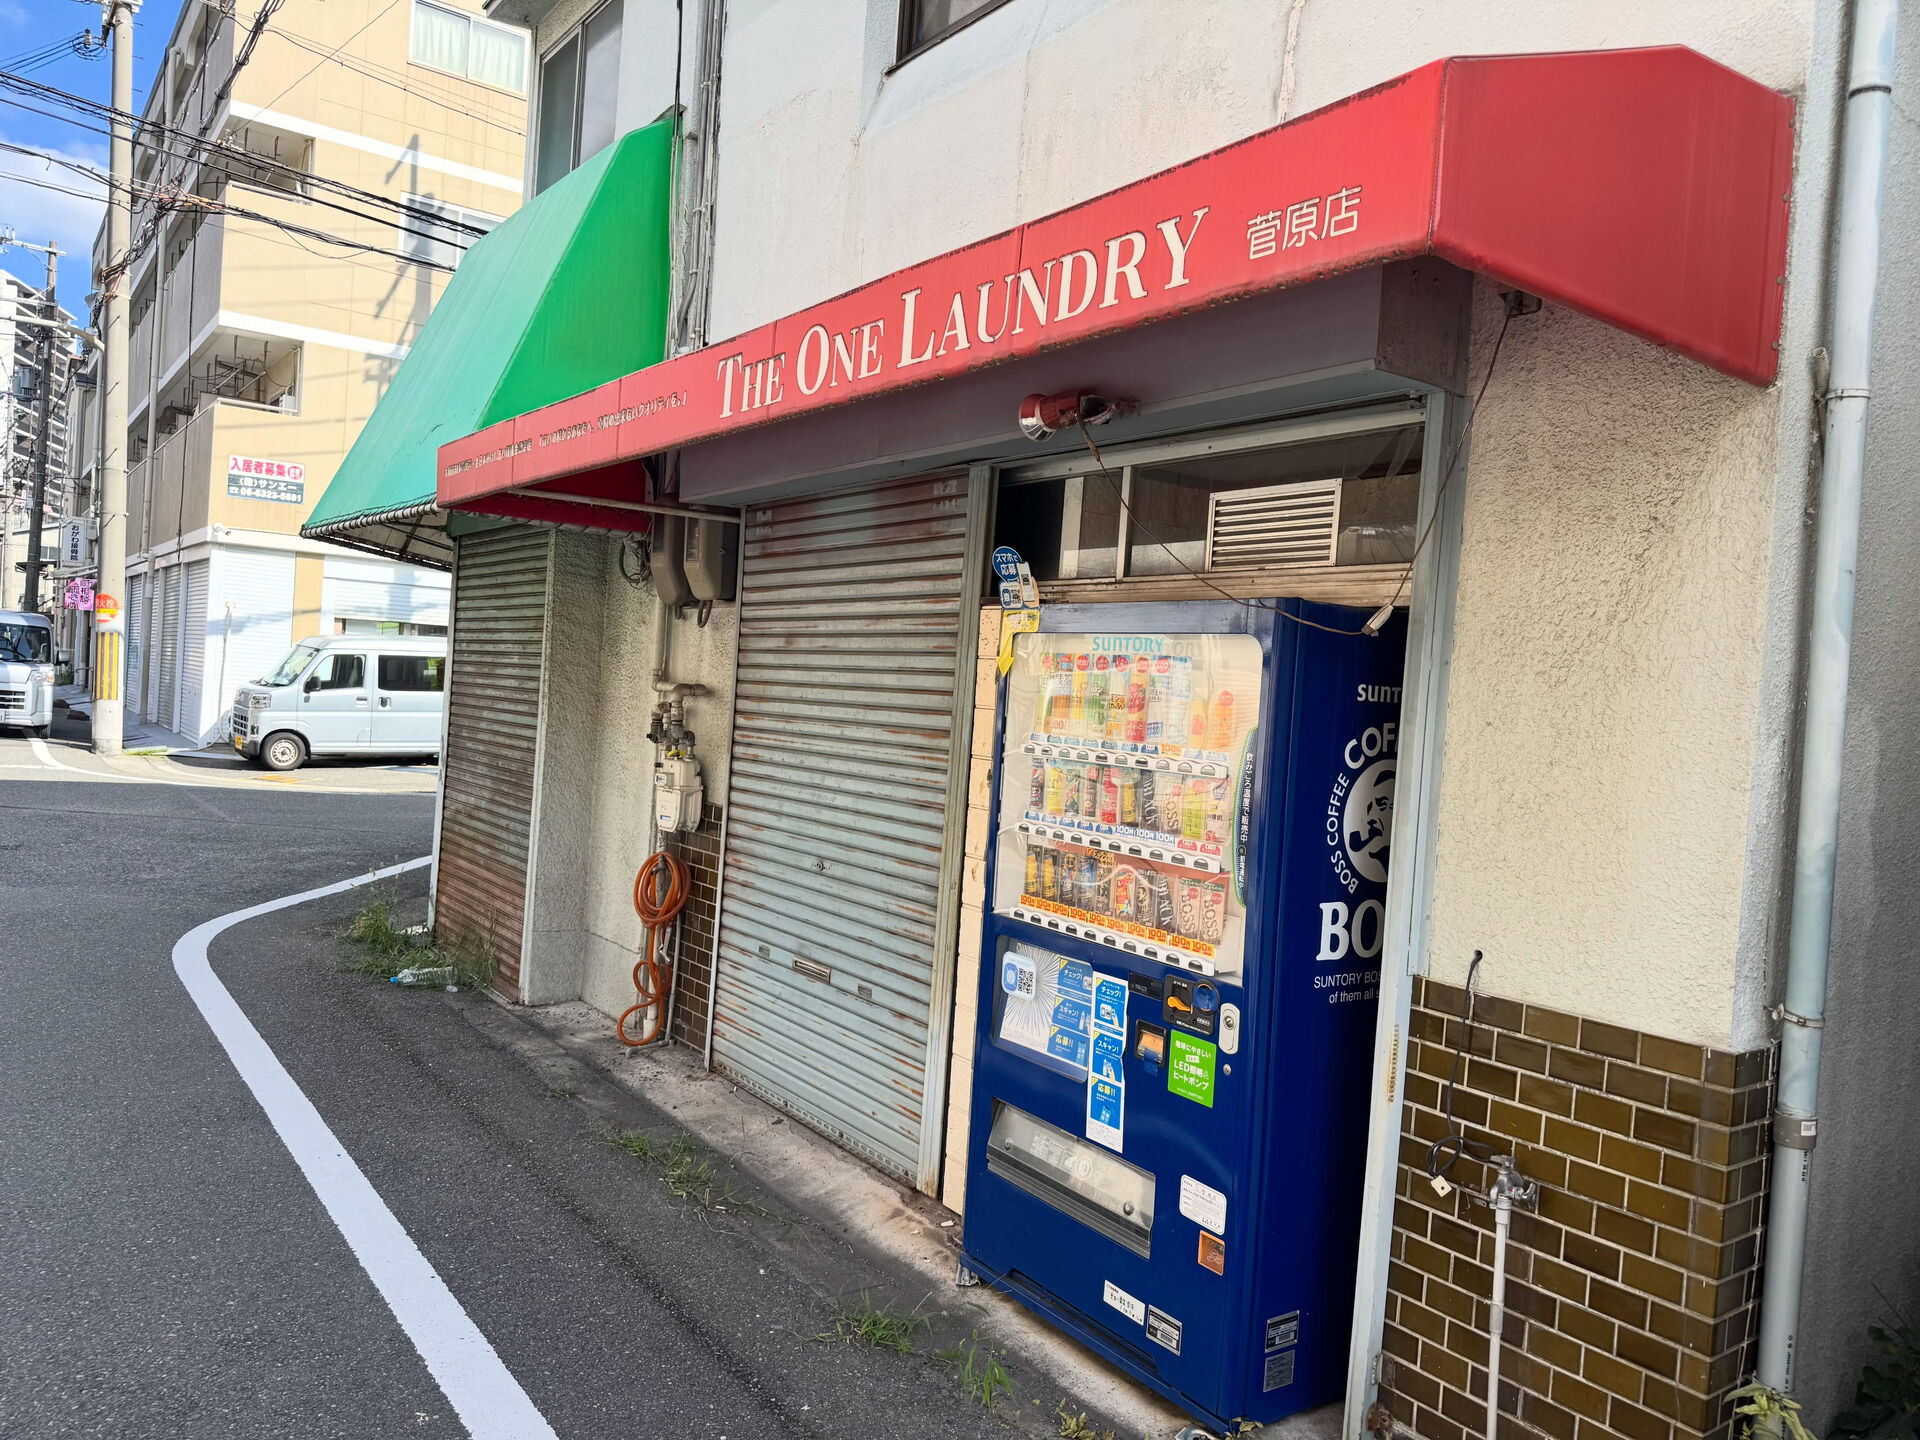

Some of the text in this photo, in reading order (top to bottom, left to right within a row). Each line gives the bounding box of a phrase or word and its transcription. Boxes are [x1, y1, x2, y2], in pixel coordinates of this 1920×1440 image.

[1246, 185, 1362, 260] 菅原店
[716, 206, 1211, 419] THE ONE LAUNDRY
[230, 456, 287, 478] 入居者募集
[995, 553, 1018, 563] スマホで
[1000, 563, 1017, 575] 応募
[1092, 636, 1164, 653] SUNTORY
[1326, 772, 1359, 894] BOSS COFFEE
[1313, 973, 1362, 989] SUNTORY
[1328, 991, 1339, 1004] of
[1340, 990, 1362, 1003] them
[1364, 987, 1374, 999] all
[1173, 1070, 1209, 1091] ヒートポンプ
